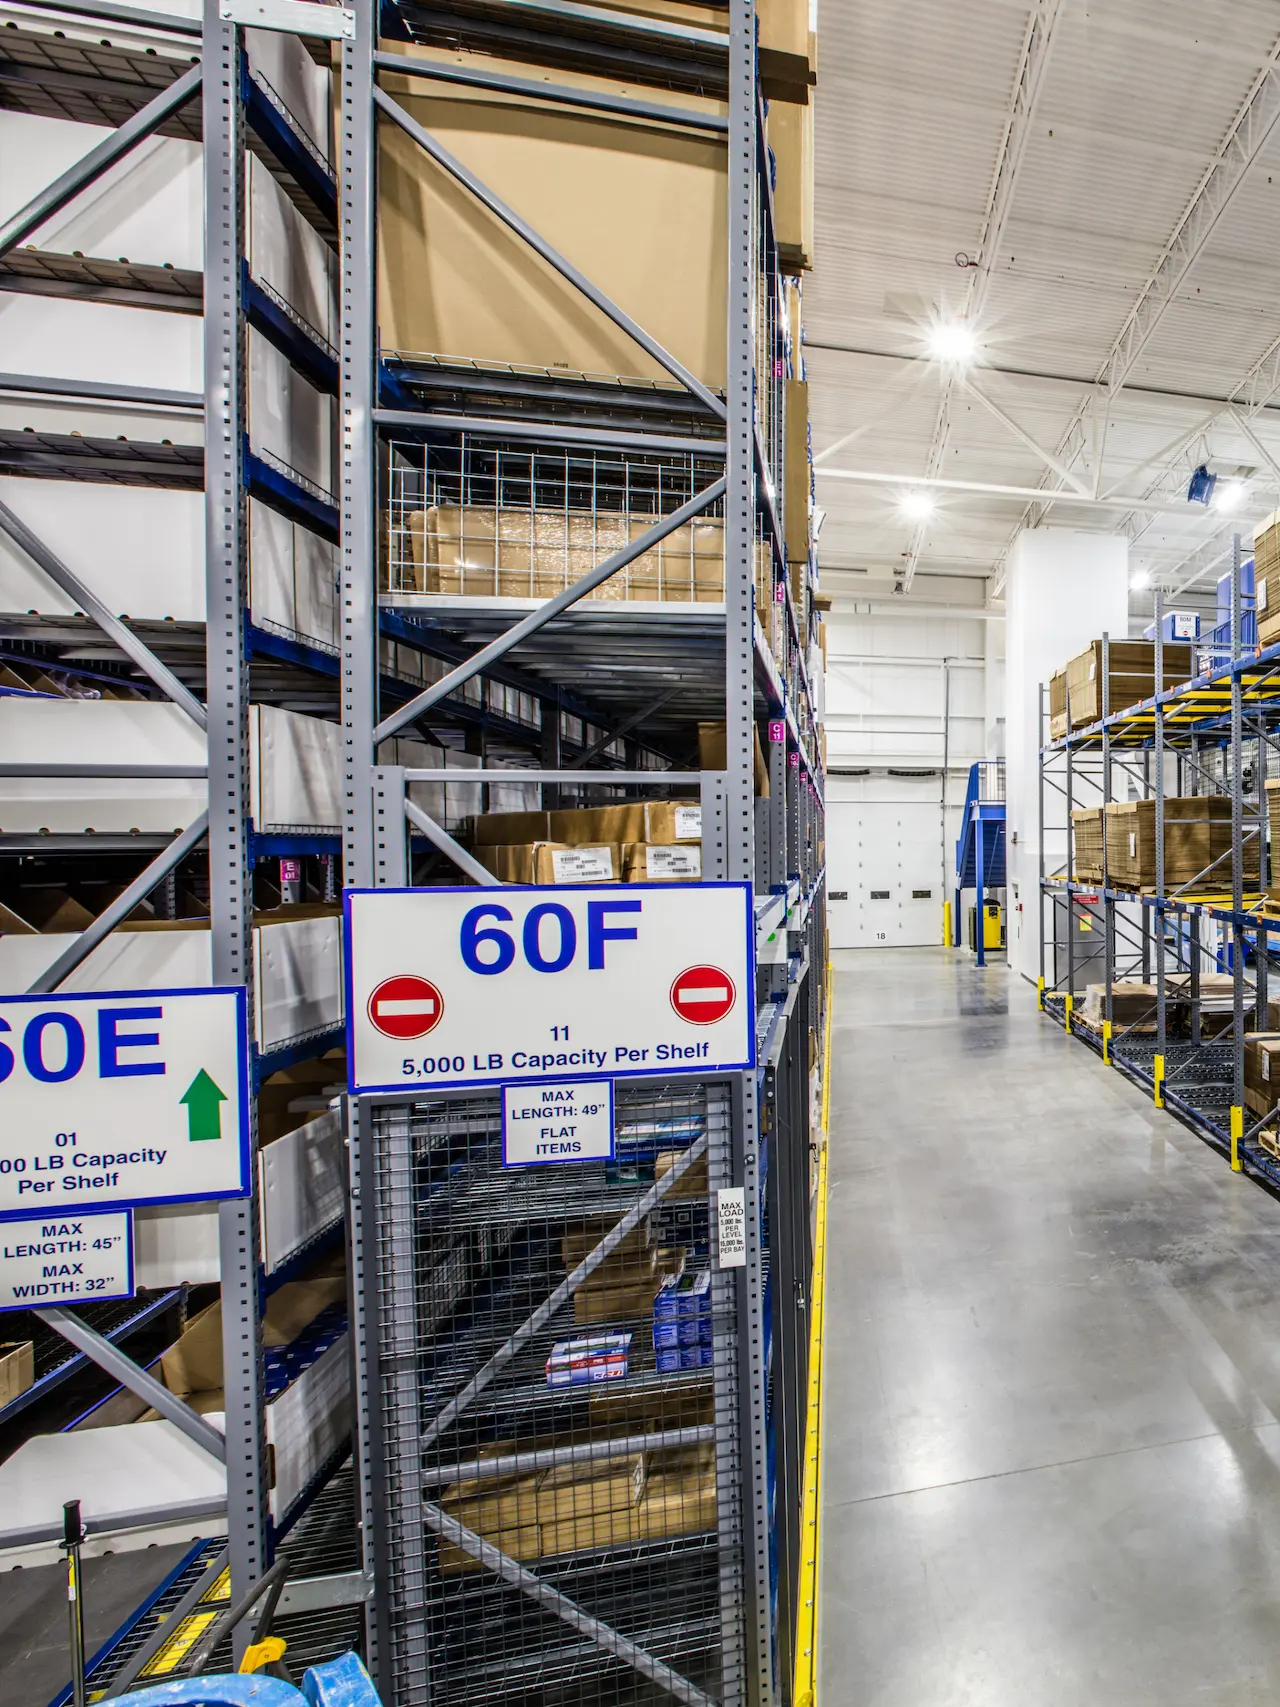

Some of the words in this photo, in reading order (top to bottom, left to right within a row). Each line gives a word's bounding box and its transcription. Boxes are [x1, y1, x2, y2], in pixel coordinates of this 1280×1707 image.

[773, 724, 781, 732] C
[286, 862, 295, 871] E
[459, 900, 642, 975] 60F
[876, 932, 886, 940] 18
[550, 1026, 570, 1041] 11
[0, 1006, 166, 1084] 0E
[402, 1056, 465, 1077] 5,000
[473, 1053, 503, 1070] LB
[511, 1049, 607, 1071] Capacity
[615, 1045, 649, 1062] Per
[656, 1042, 709, 1060] Shelf
[542, 1090, 575, 1102] MAX
[512, 1106, 578, 1120] LENGTH:
[541, 1126, 577, 1138] FLAT
[55, 1132, 77, 1147] 01
[536, 1142, 581, 1155] ITEMS
[35, 1155, 64, 1170] LB
[72, 1149, 167, 1168] Capacity
[18, 1180, 55, 1194] Per
[62, 1173, 119, 1190] Shelf
[720, 1209, 744, 1217] LOAD
[721, 1202, 741, 1210] MAX
[42, 1223, 83, 1237] MAX
[722, 1231, 742, 1239] LEVEL
[4, 1240, 87, 1258] LENGTH:
[42, 1263, 84, 1277] MAX
[13, 1280, 80, 1298] WIDTH:
